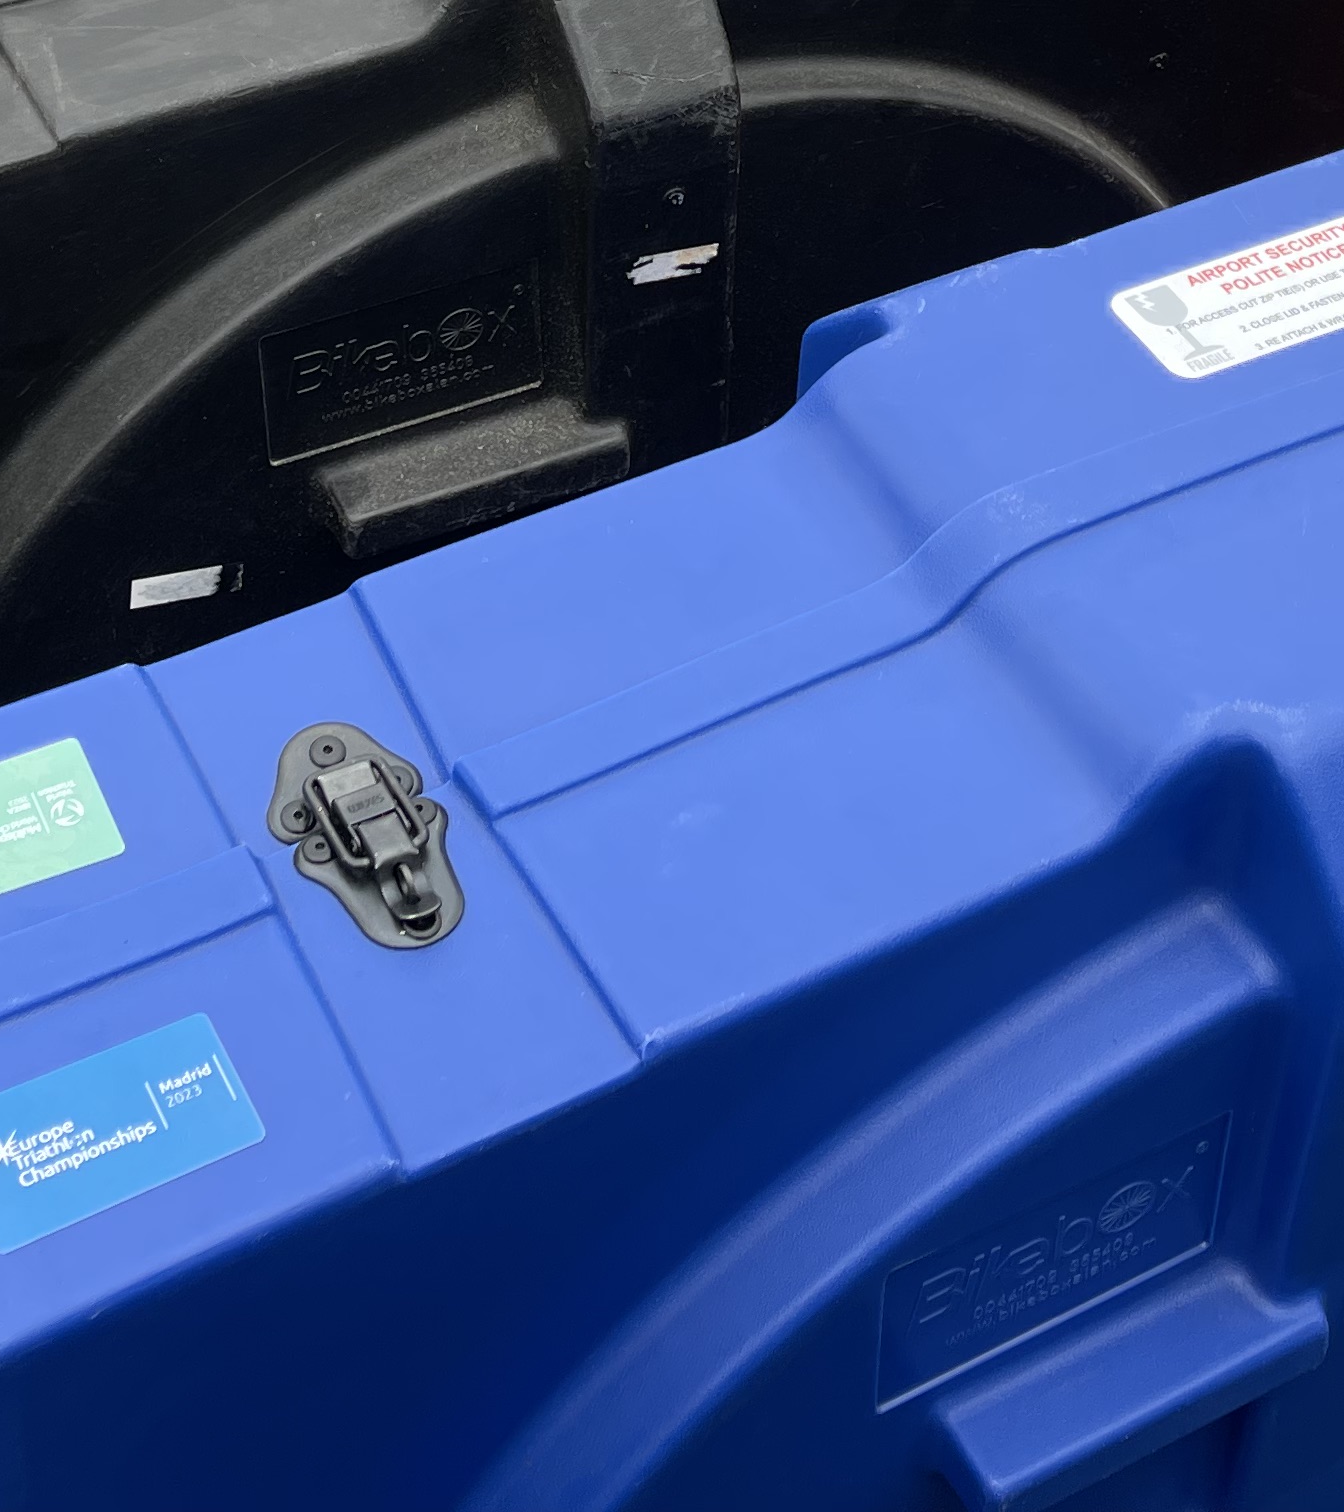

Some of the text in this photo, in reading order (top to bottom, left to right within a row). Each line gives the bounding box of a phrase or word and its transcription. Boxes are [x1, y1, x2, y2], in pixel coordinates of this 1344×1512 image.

[1183, 251, 1267, 287] AIRPORT
[1220, 265, 1287, 295] POLITE
[1175, 318, 1202, 333] FOR
[1197, 305, 1240, 325] ACCESS
[1235, 298, 1261, 312] CUT
[1257, 292, 1278, 304] ZIP
[1273, 282, 1306, 299] TIE(S)
[1302, 277, 1323, 289] OR
[1317, 270, 1343, 283] USE
[1238, 324, 1251, 333] 2.
[1248, 312, 1286, 330] CLOSE
[1281, 306, 1303, 318] LID
[1298, 303, 1311, 312] &
[1253, 341, 1266, 351] 3.
[1264, 336, 1283, 347] RE
[1279, 323, 1319, 342] ATTACH
[1314, 320, 1328, 330] &
[1185, 347, 1236, 373] FRAGILE
[158, 1063, 212, 1094] Madrid
[165, 1084, 203, 1108] 2023
[8, 1119, 75, 1157] Europe
[18, 1119, 158, 1187] Championships
